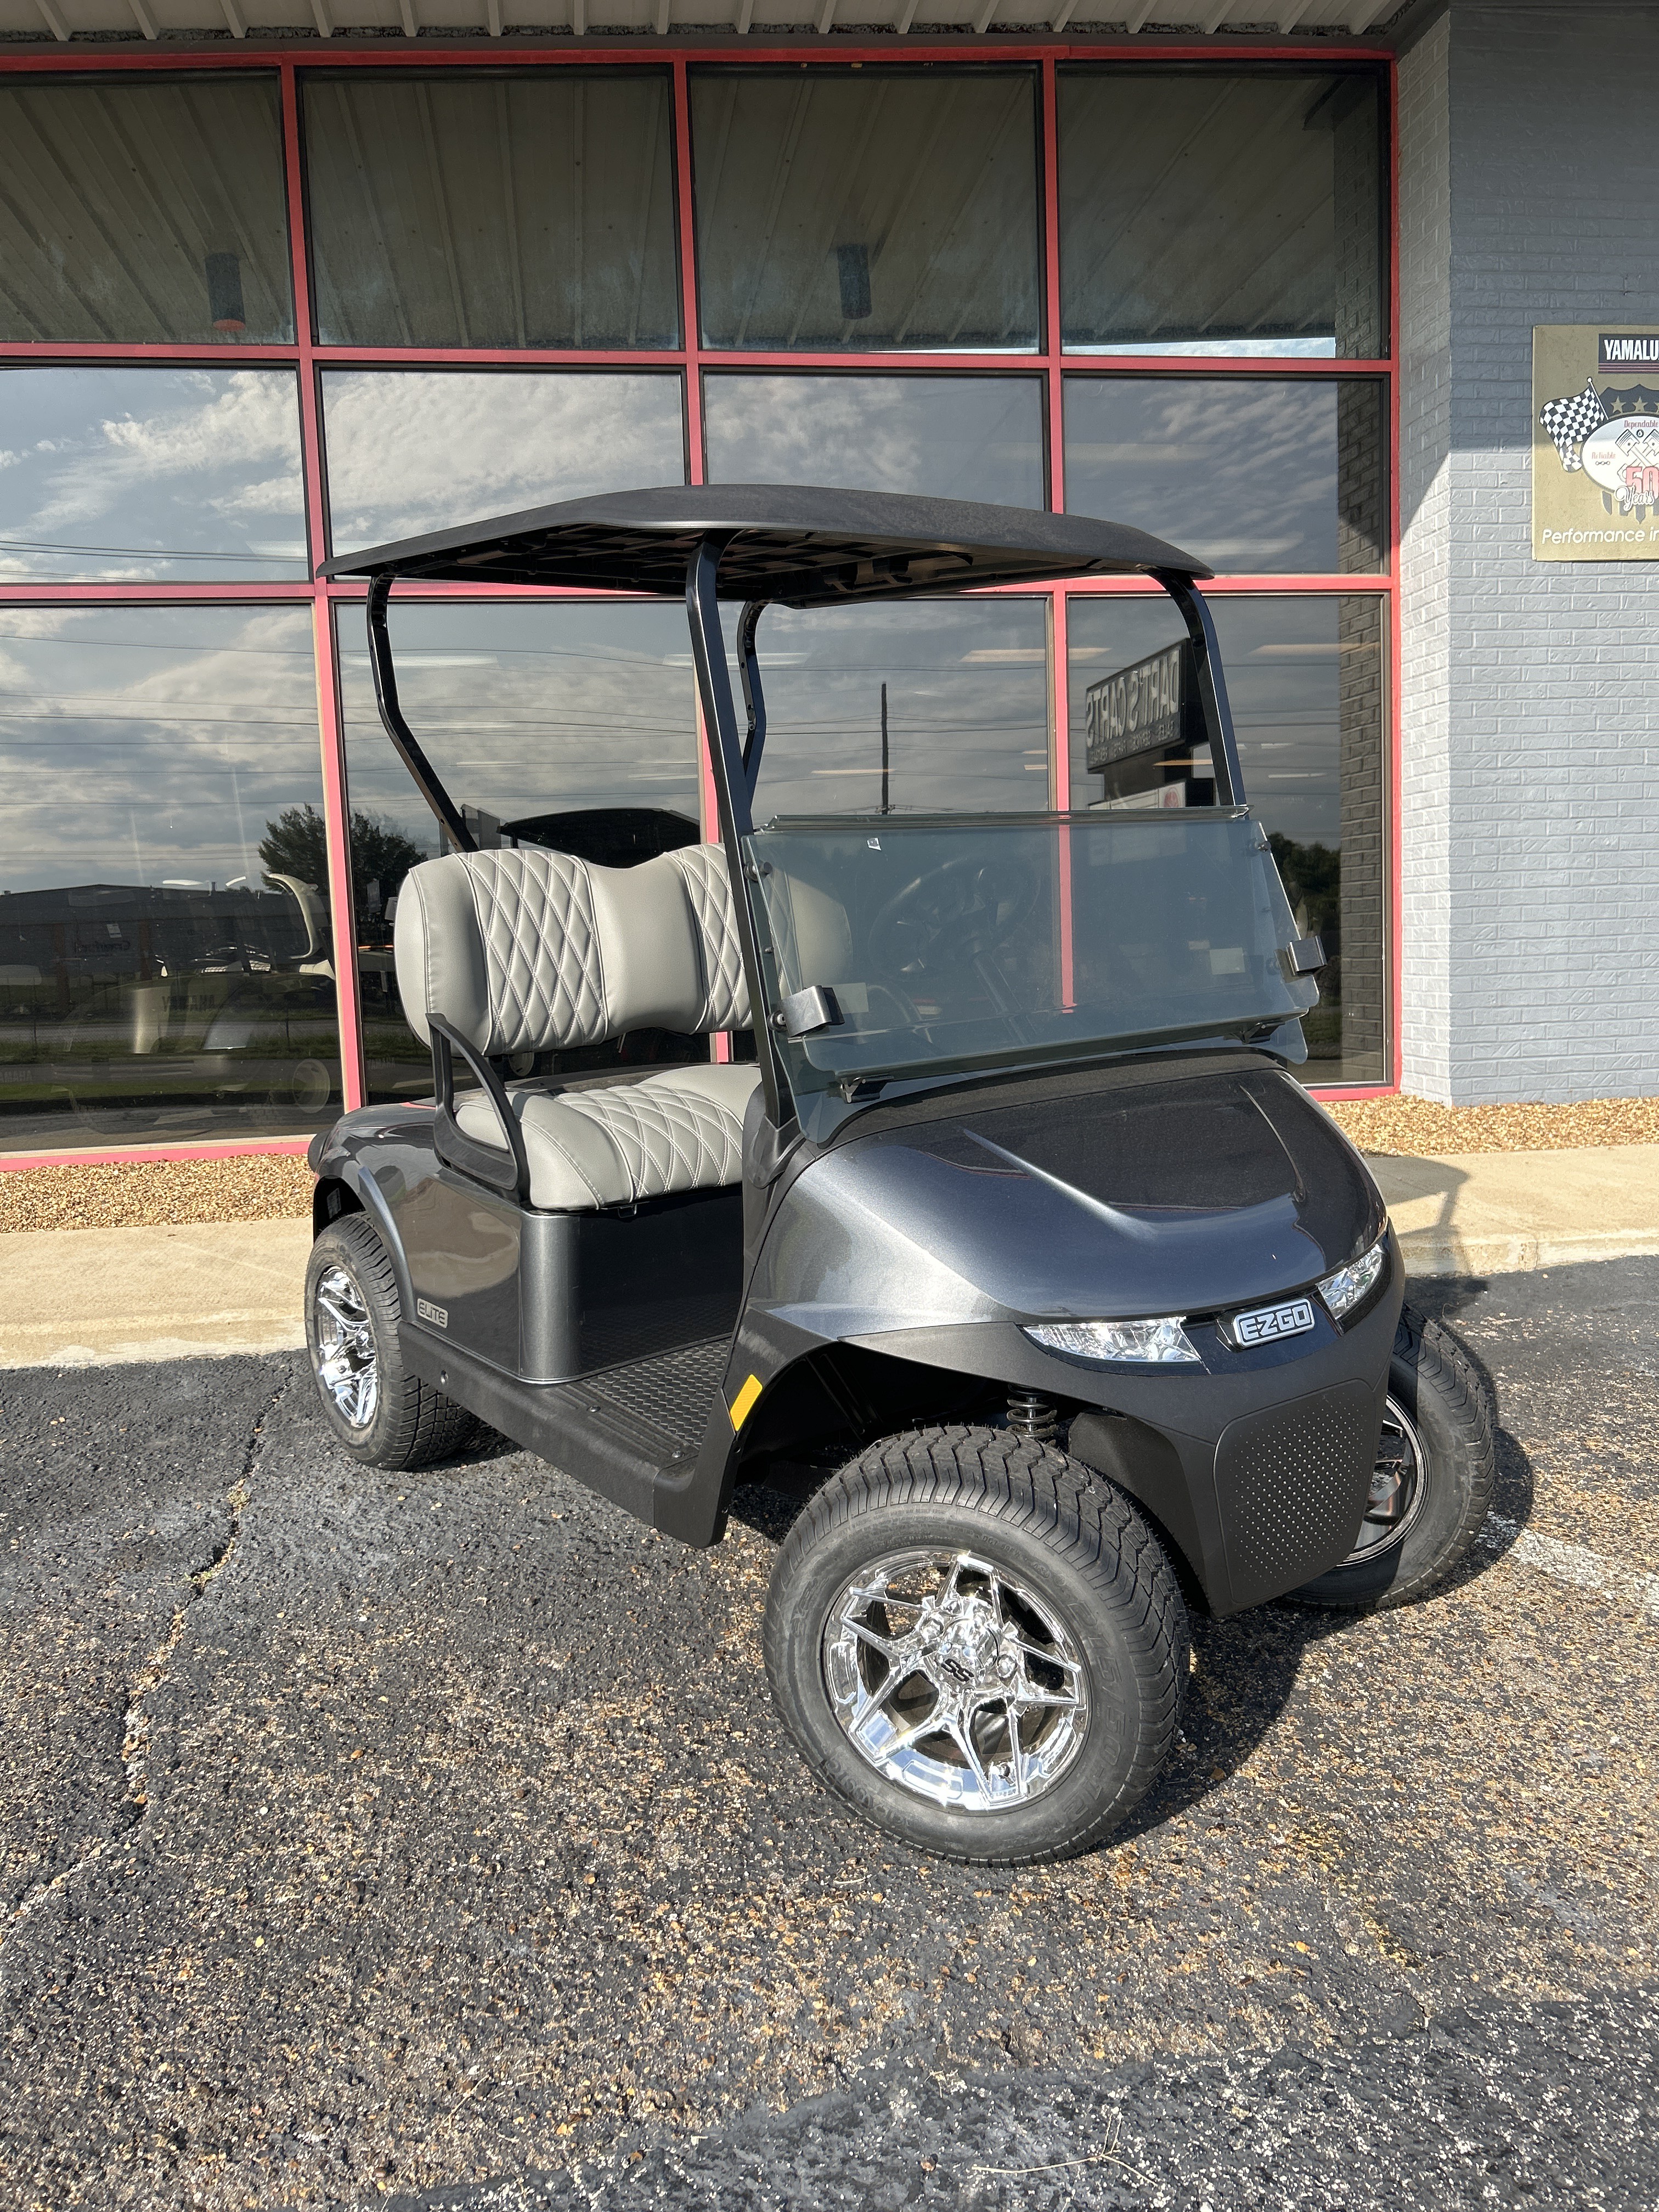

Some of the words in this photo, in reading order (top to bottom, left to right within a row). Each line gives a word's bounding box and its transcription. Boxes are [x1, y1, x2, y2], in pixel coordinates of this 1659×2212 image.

[1604, 339, 1659, 360] YAMALU
[1624, 420, 1658, 430] Dependable
[1592, 452, 1616, 460] Reliable
[1626, 466, 1659, 499] 50
[1615, 485, 1655, 511] Years
[1542, 527, 1645, 544] Performance
